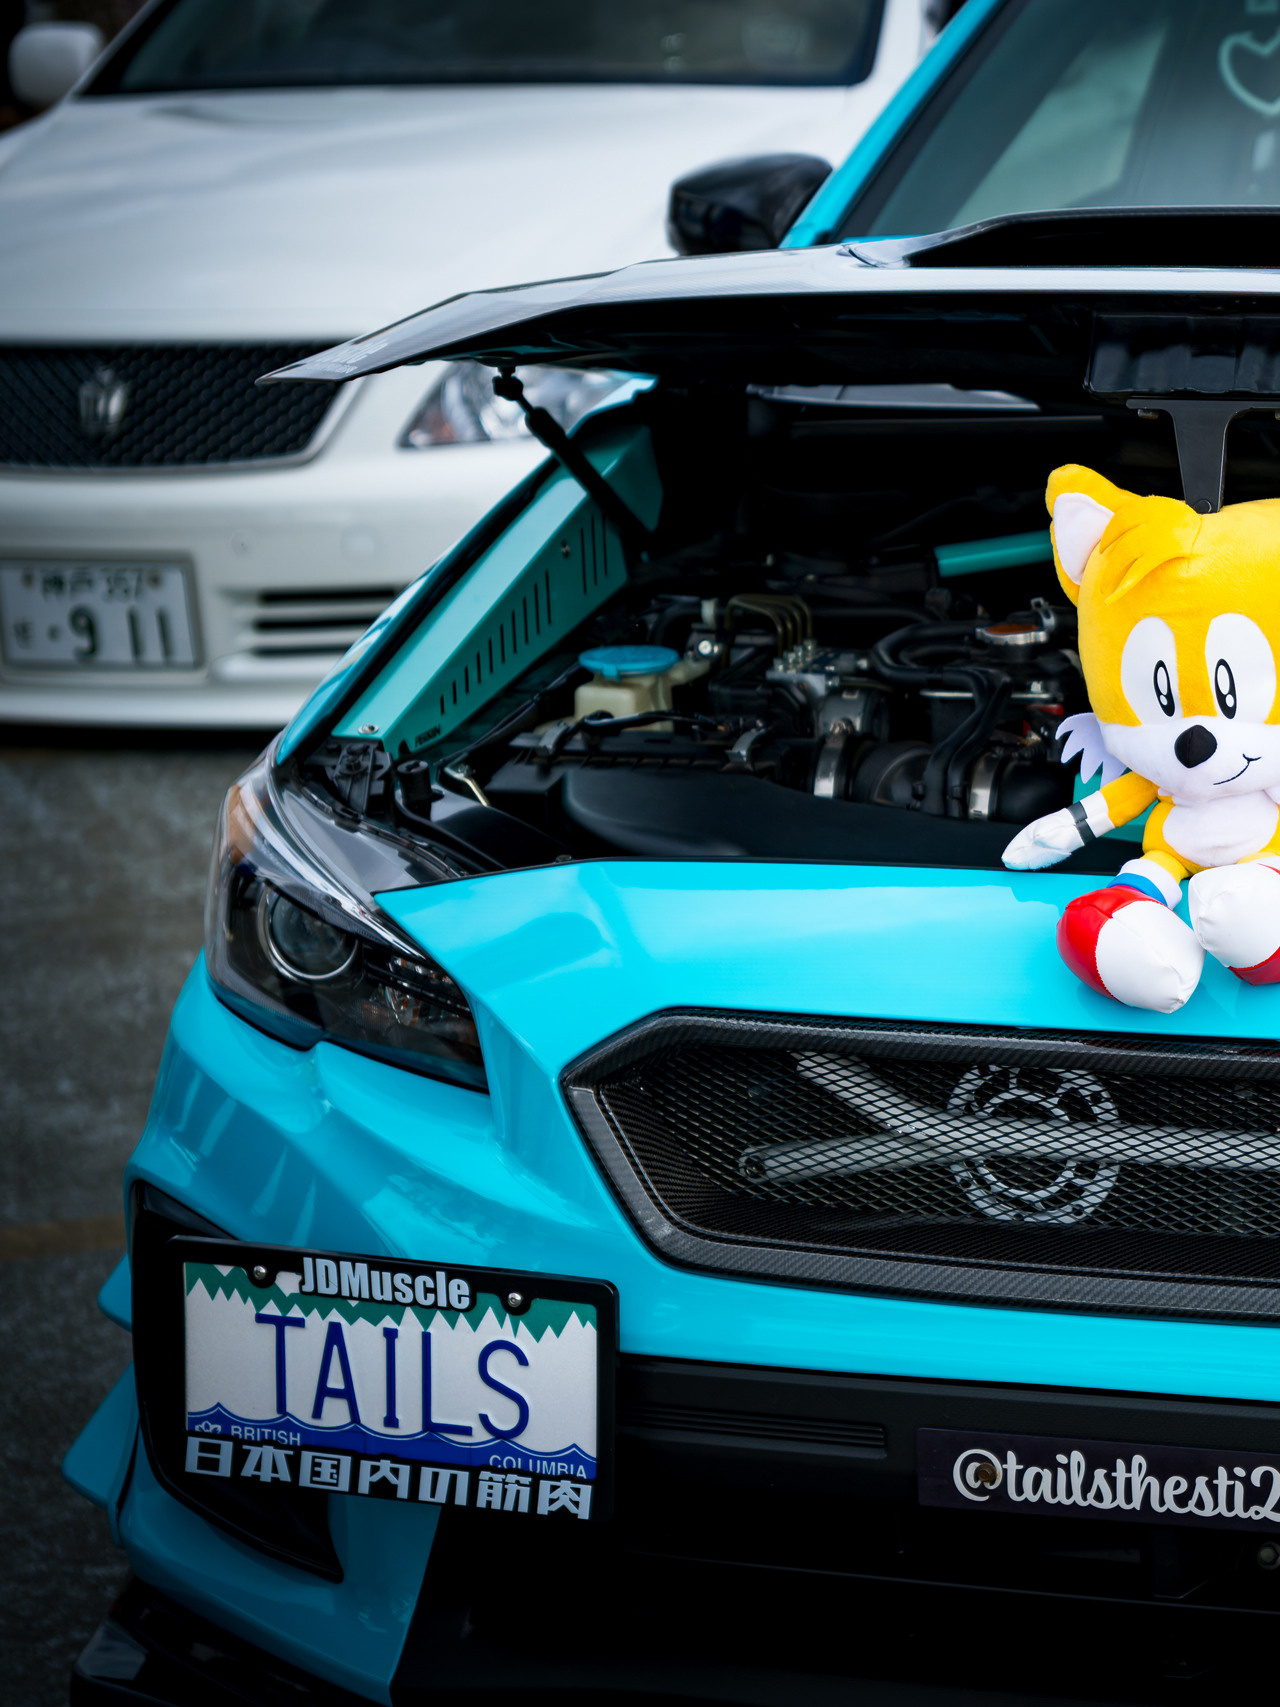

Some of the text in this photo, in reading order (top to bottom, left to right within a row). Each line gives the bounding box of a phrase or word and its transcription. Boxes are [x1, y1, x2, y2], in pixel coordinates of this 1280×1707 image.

[301, 1256, 471, 1311] JDMuscle
[254, 1312, 530, 1441] TAILS
[230, 1425, 300, 1447] BRITISH
[184, 1435, 593, 1521] 日本国内の筋肉
[489, 1454, 588, 1480] COLUMBIA
